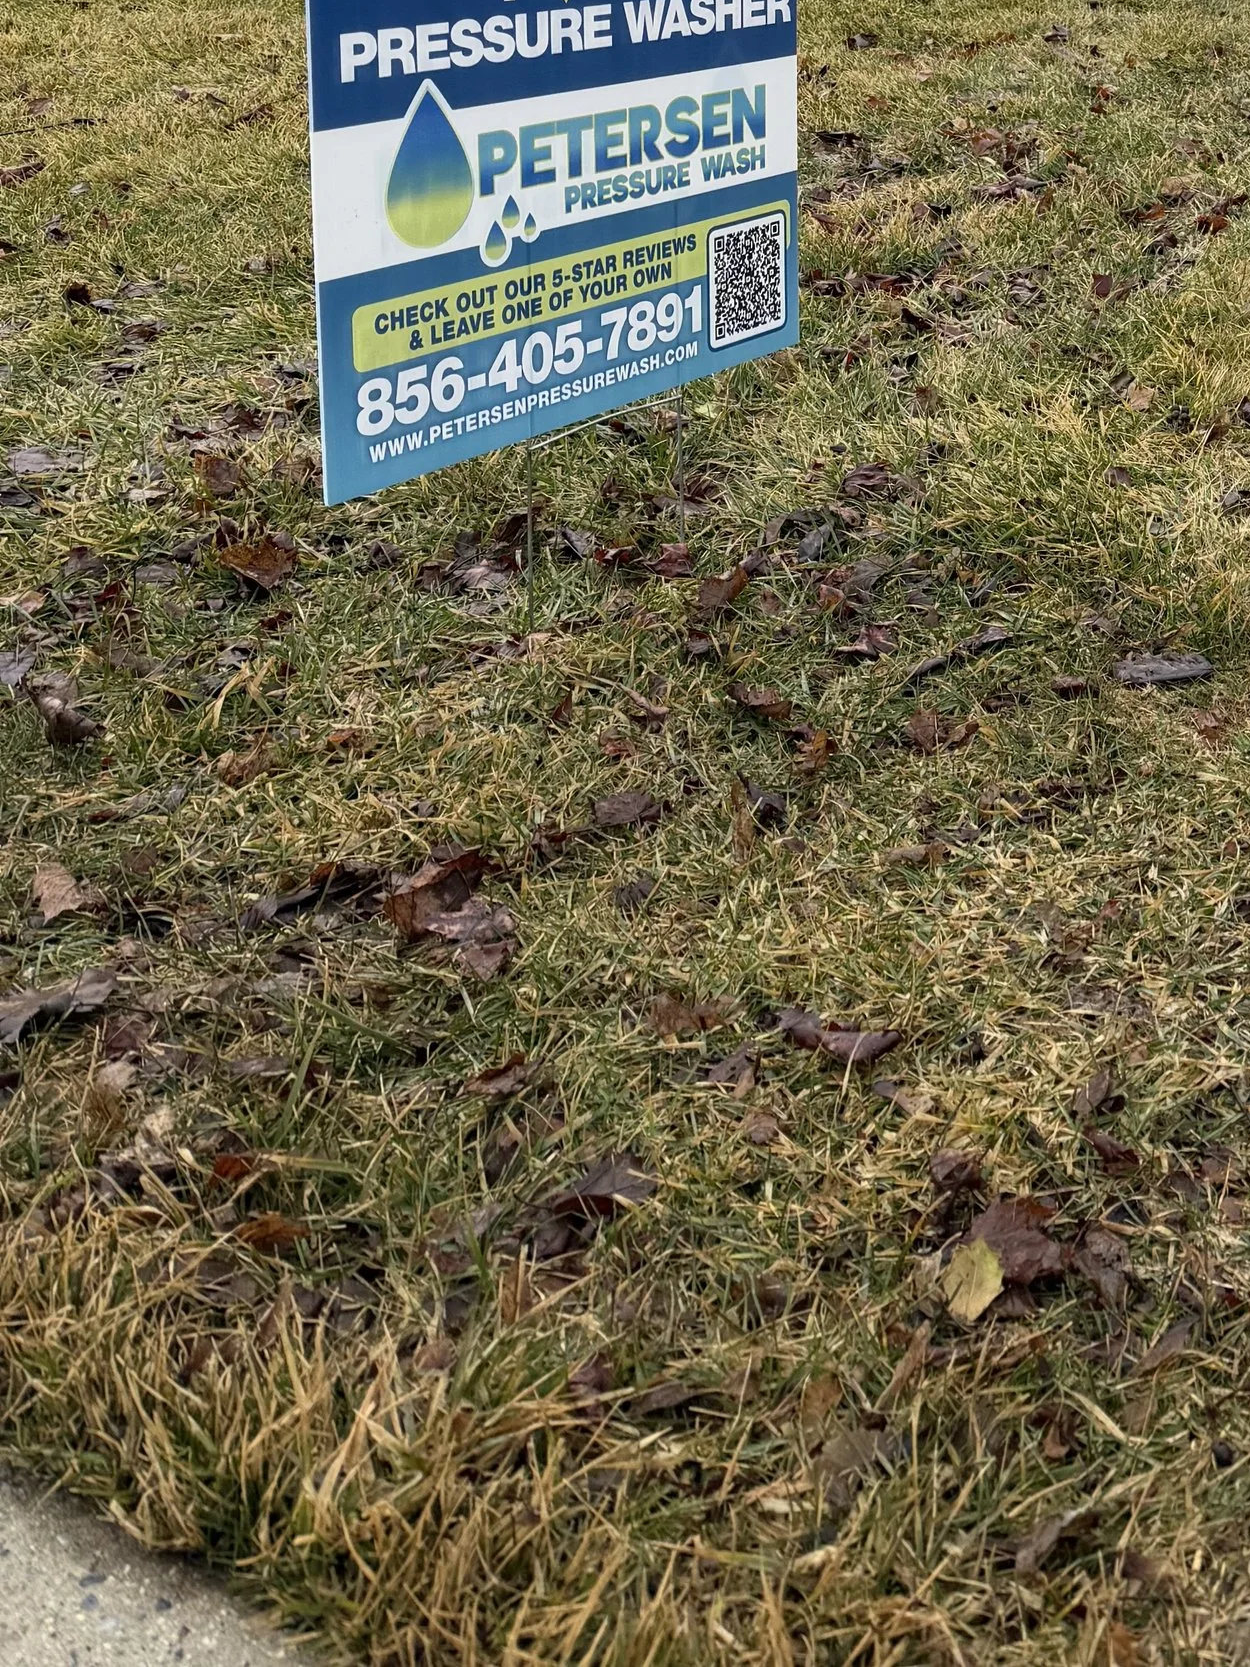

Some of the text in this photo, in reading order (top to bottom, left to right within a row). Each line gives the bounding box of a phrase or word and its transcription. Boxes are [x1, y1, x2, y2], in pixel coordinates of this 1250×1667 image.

[339, 4, 613, 83] PRESSURE
[478, 84, 767, 198] PETERSEN
[564, 144, 766, 214] PRESSURE WASH
[374, 234, 697, 335] CHECK OUT OUR 5-STAR REVIEWS
[409, 262, 672, 351] & LEAVE ONE OF YOUR OWN
[356, 285, 703, 437] 856-405-7891
[369, 341, 699, 464] WWW.PETERSENPRESSUREWASH.COM
